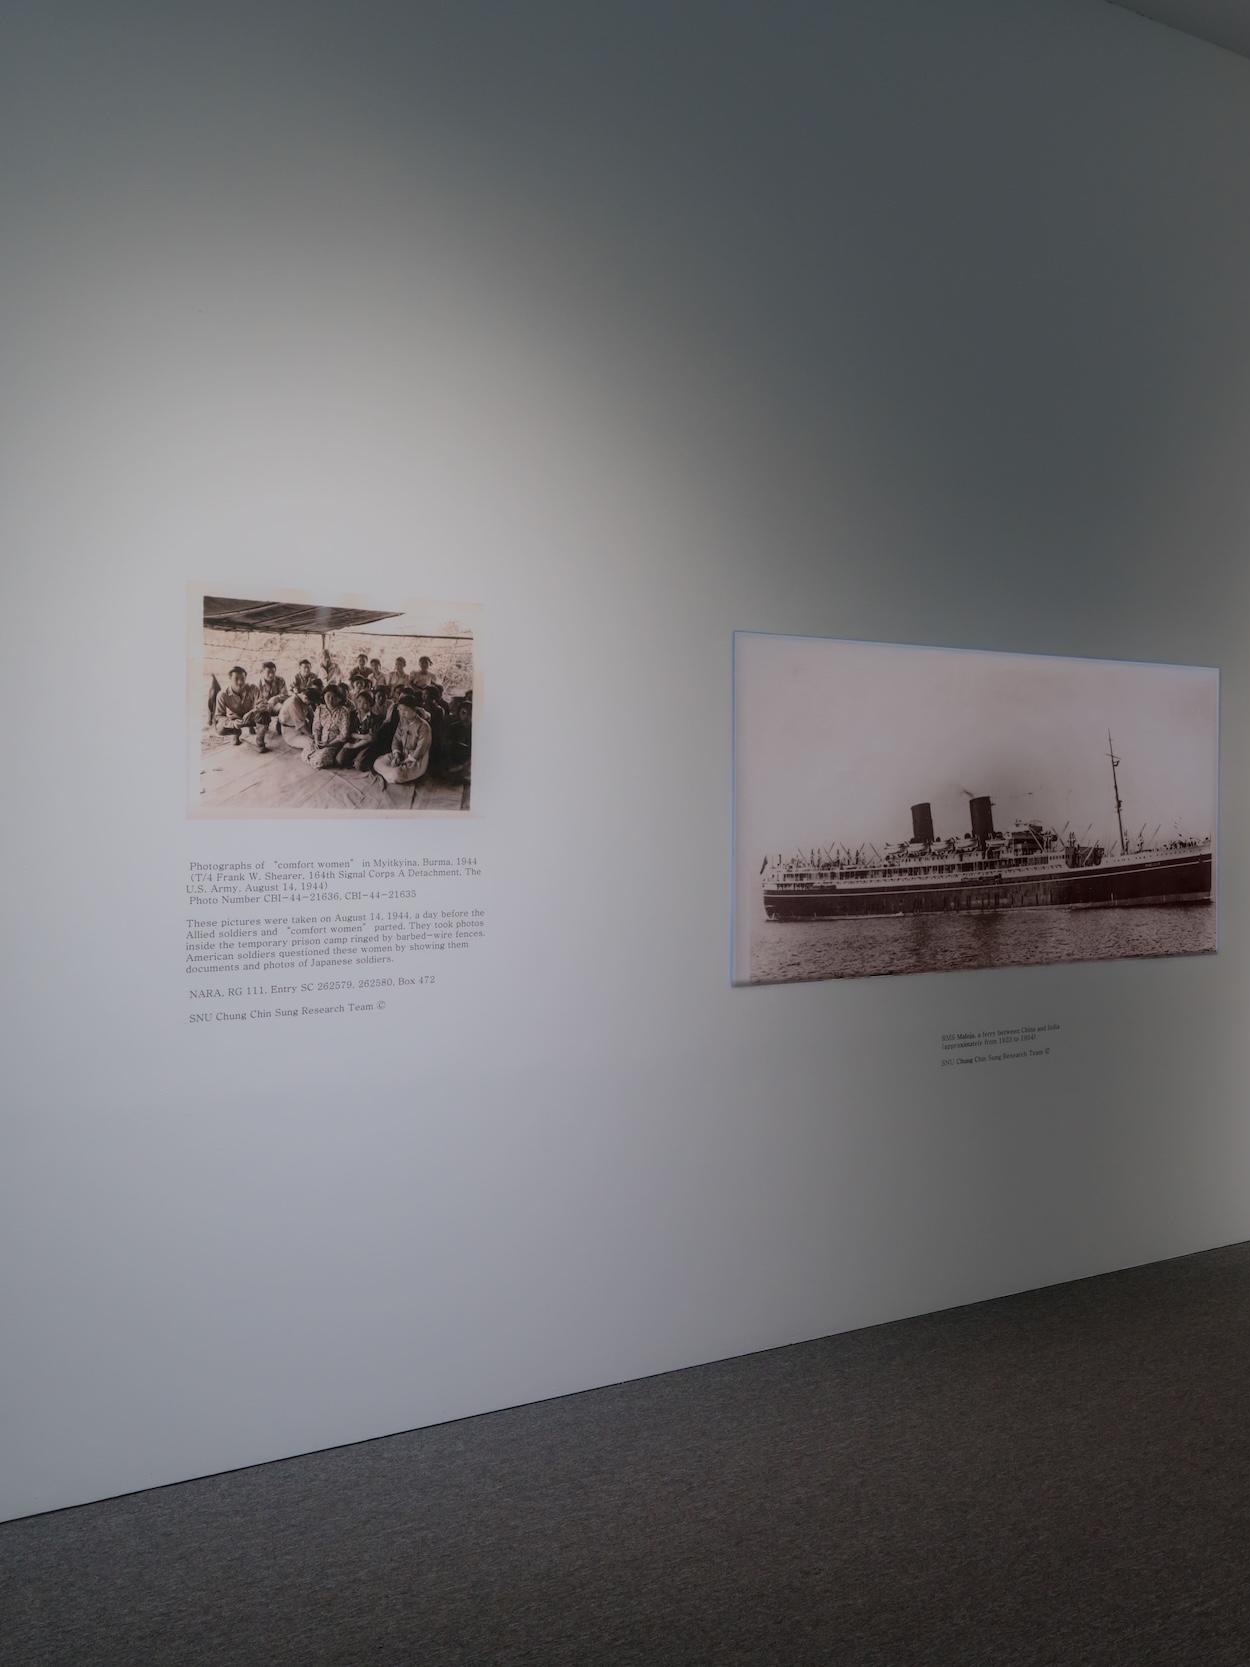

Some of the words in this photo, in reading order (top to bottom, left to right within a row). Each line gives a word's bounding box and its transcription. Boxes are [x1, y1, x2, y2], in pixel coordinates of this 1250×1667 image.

[190, 861, 252, 871] Photographs
[255, 860, 265, 870] of
[362, 859, 370, 868] in
[457, 857, 477, 866] 1944
[190, 873, 212, 883] (T/4
[216, 872, 245, 882] Frank
[248, 872, 261, 881] W.
[309, 871, 335, 879] 164th
[338, 870, 366, 880] Signal
[368, 869, 395, 879] Corps
[398, 869, 405, 877] A
[464, 867, 482, 876] The
[186, 884, 207, 894] U.S.
[245, 884, 279, 893] August
[301, 881, 328, 891] 1944)
[189, 896, 219, 905] Photo
[221, 895, 261, 904] Number
[186, 919, 218, 928] These
[221, 917, 261, 928] pictures
[291, 915, 317, 924] taken
[334, 914, 366, 924] August
[423, 910, 438, 919] day
[441, 909, 469, 918] before
[471, 909, 485, 917] the
[186, 930, 215, 940] Allied
[219, 928, 258, 938] soldiers
[261, 927, 278, 937] and
[374, 922, 406, 933] parted.
[409, 921, 432, 933] They
[434, 920, 453, 929] took
[456, 920, 484, 932] photos
[185, 941, 216, 951] inside
[219, 941, 235, 949] the
[238, 940, 288, 949] temporary
[291, 937, 321, 947] prison
[323, 937, 348, 945] camp
[350, 934, 379, 944] ringed
[382, 934, 393, 943] by
[396, 931, 453, 941] barbed-wire
[455, 930, 485, 938] fences.
[186, 952, 234, 962] American
[237, 950, 276, 960] soldiers
[279, 947, 330, 957] questioned
[333, 946, 358, 955] these
[361, 946, 393, 954] women
[395, 943, 406, 952] by
[409, 942, 445, 951] showing
[448, 941, 469, 949] them
[185, 964, 240, 974] documents
[243, 961, 260, 971] and
[263, 961, 295, 971] photos
[298, 958, 308, 968] of
[310, 958, 353, 968] Japanese
[356, 956, 394, 964] soldiers.
[228, 987, 243, 997] RG
[271, 985, 298, 994] Entry
[301, 983, 314, 992] SC
[398, 977, 416, 986] Box
[419, 975, 435, 984] 472
[189, 1013, 212, 1023] SNU
[215, 1012, 247, 1021] Chung
[250, 1009, 272, 1019] Chin
[275, 1008, 299, 1017] Sung
[301, 1004, 345, 1015] Research
[348, 1003, 374, 1012] Team
